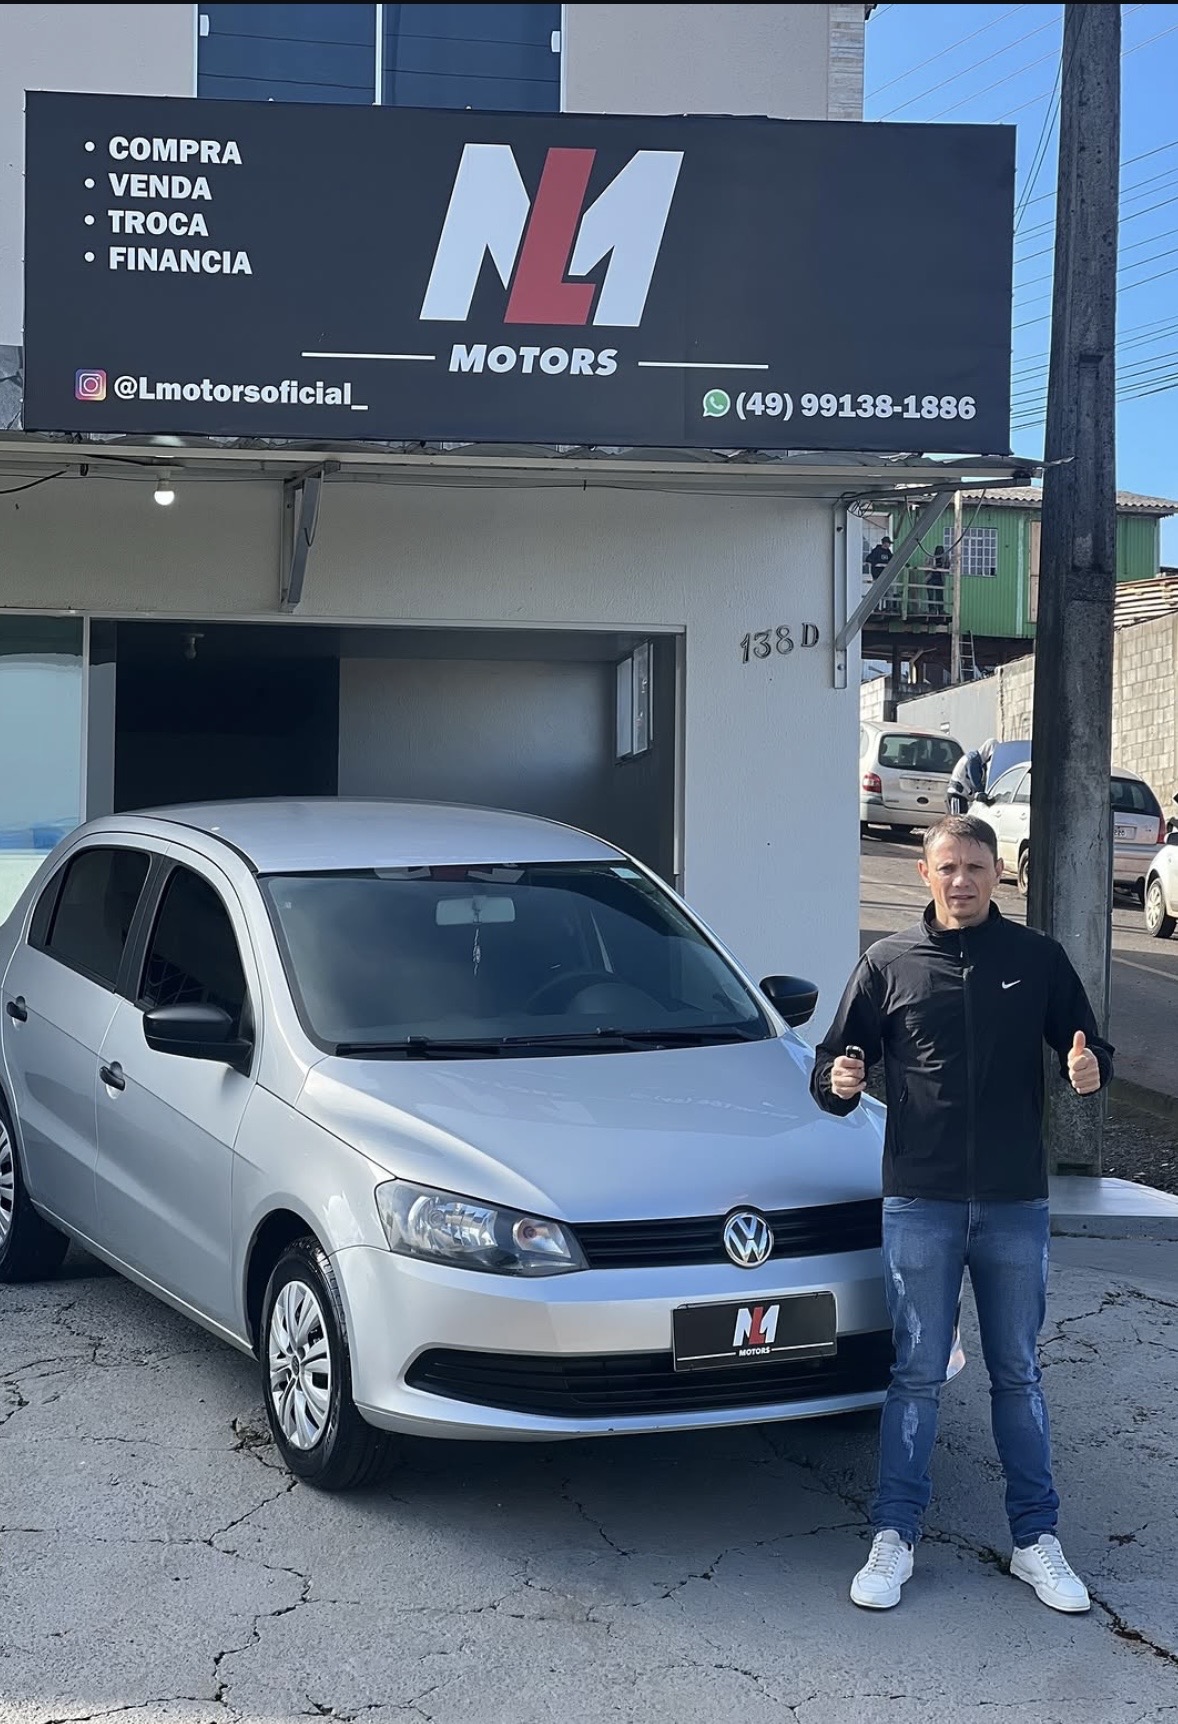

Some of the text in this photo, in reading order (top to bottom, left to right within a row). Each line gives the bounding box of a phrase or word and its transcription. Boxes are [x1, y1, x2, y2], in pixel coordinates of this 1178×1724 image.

[108, 136, 243, 166] COMPRA
[108, 172, 213, 201] VENDA
[107, 209, 209, 237] TROCA
[108, 246, 253, 275] FINANCIA
[448, 344, 618, 376] MOTORS
[113, 375, 369, 411] @Lmotorsoficial_
[735, 391, 977, 422] (49) 99138-1886
[740, 622, 819, 664] 138 D
[738, 1346, 770, 1357] MOTORS
